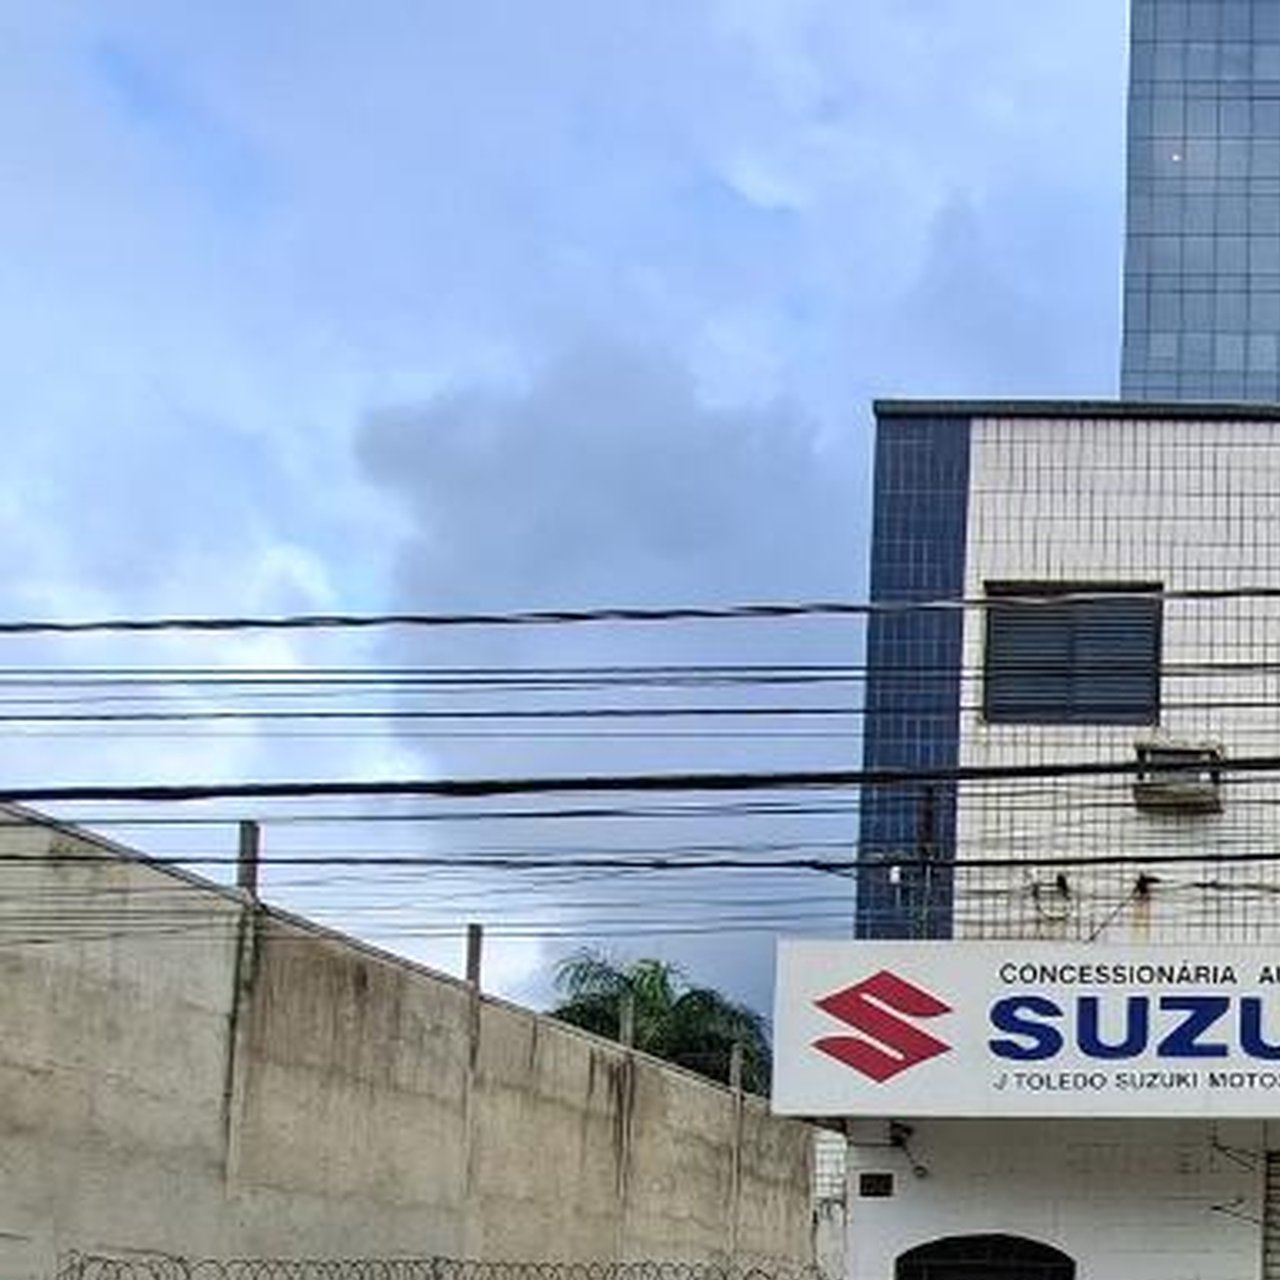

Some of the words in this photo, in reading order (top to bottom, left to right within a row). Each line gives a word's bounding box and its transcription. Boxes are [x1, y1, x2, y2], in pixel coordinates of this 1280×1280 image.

[999, 963, 1237, 985] CONCESSIONÁRIA
[1013, 1073, 1107, 1090] TOLEDO
[1115, 1073, 1198, 1089] SUZUKI
